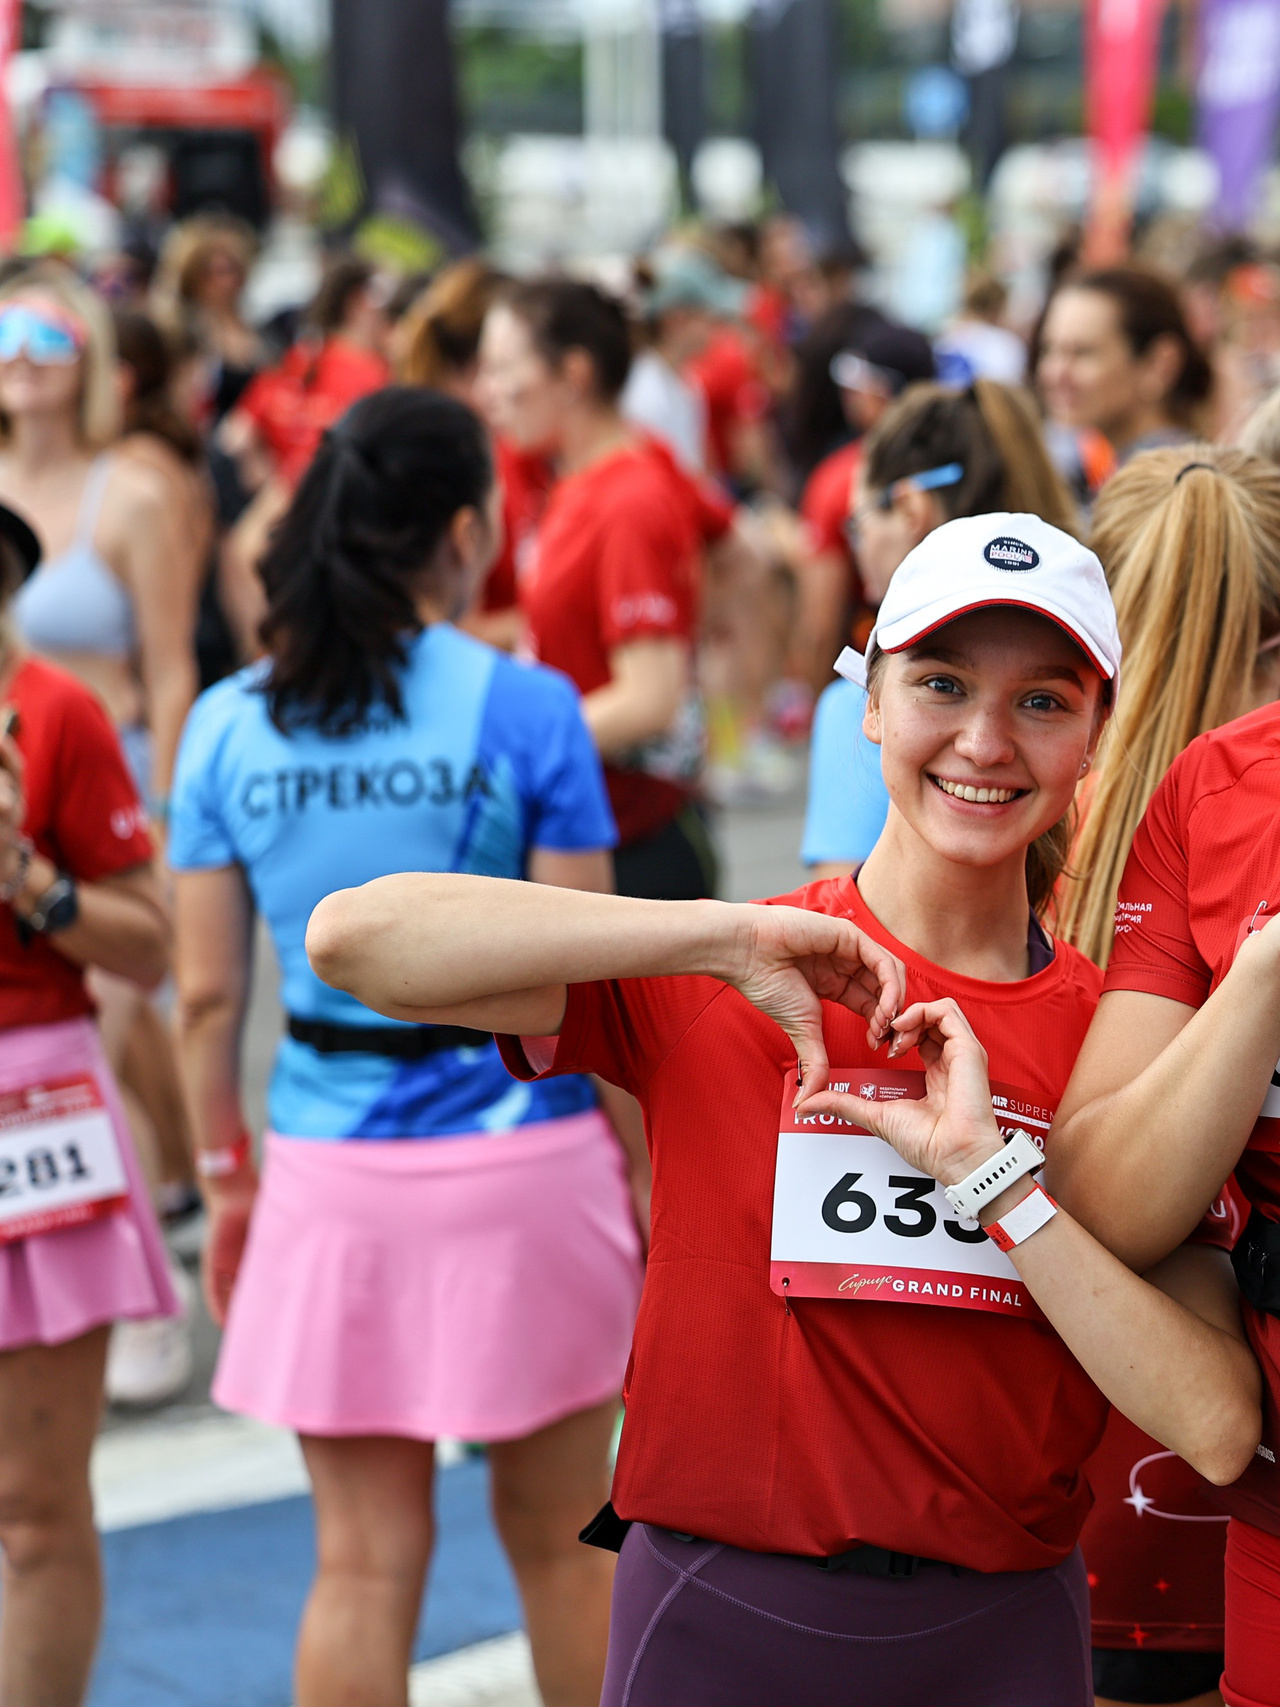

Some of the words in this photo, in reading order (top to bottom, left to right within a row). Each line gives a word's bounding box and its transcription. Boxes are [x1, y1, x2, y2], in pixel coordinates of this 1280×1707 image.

[991, 544, 1034, 556] MARINE
[241, 758, 493, 819] СТРЕКОЗА
[828, 1082, 850, 1093] LADY
[892, 1279, 963, 1297] GRAND
[970, 1287, 1022, 1306] FINAL
